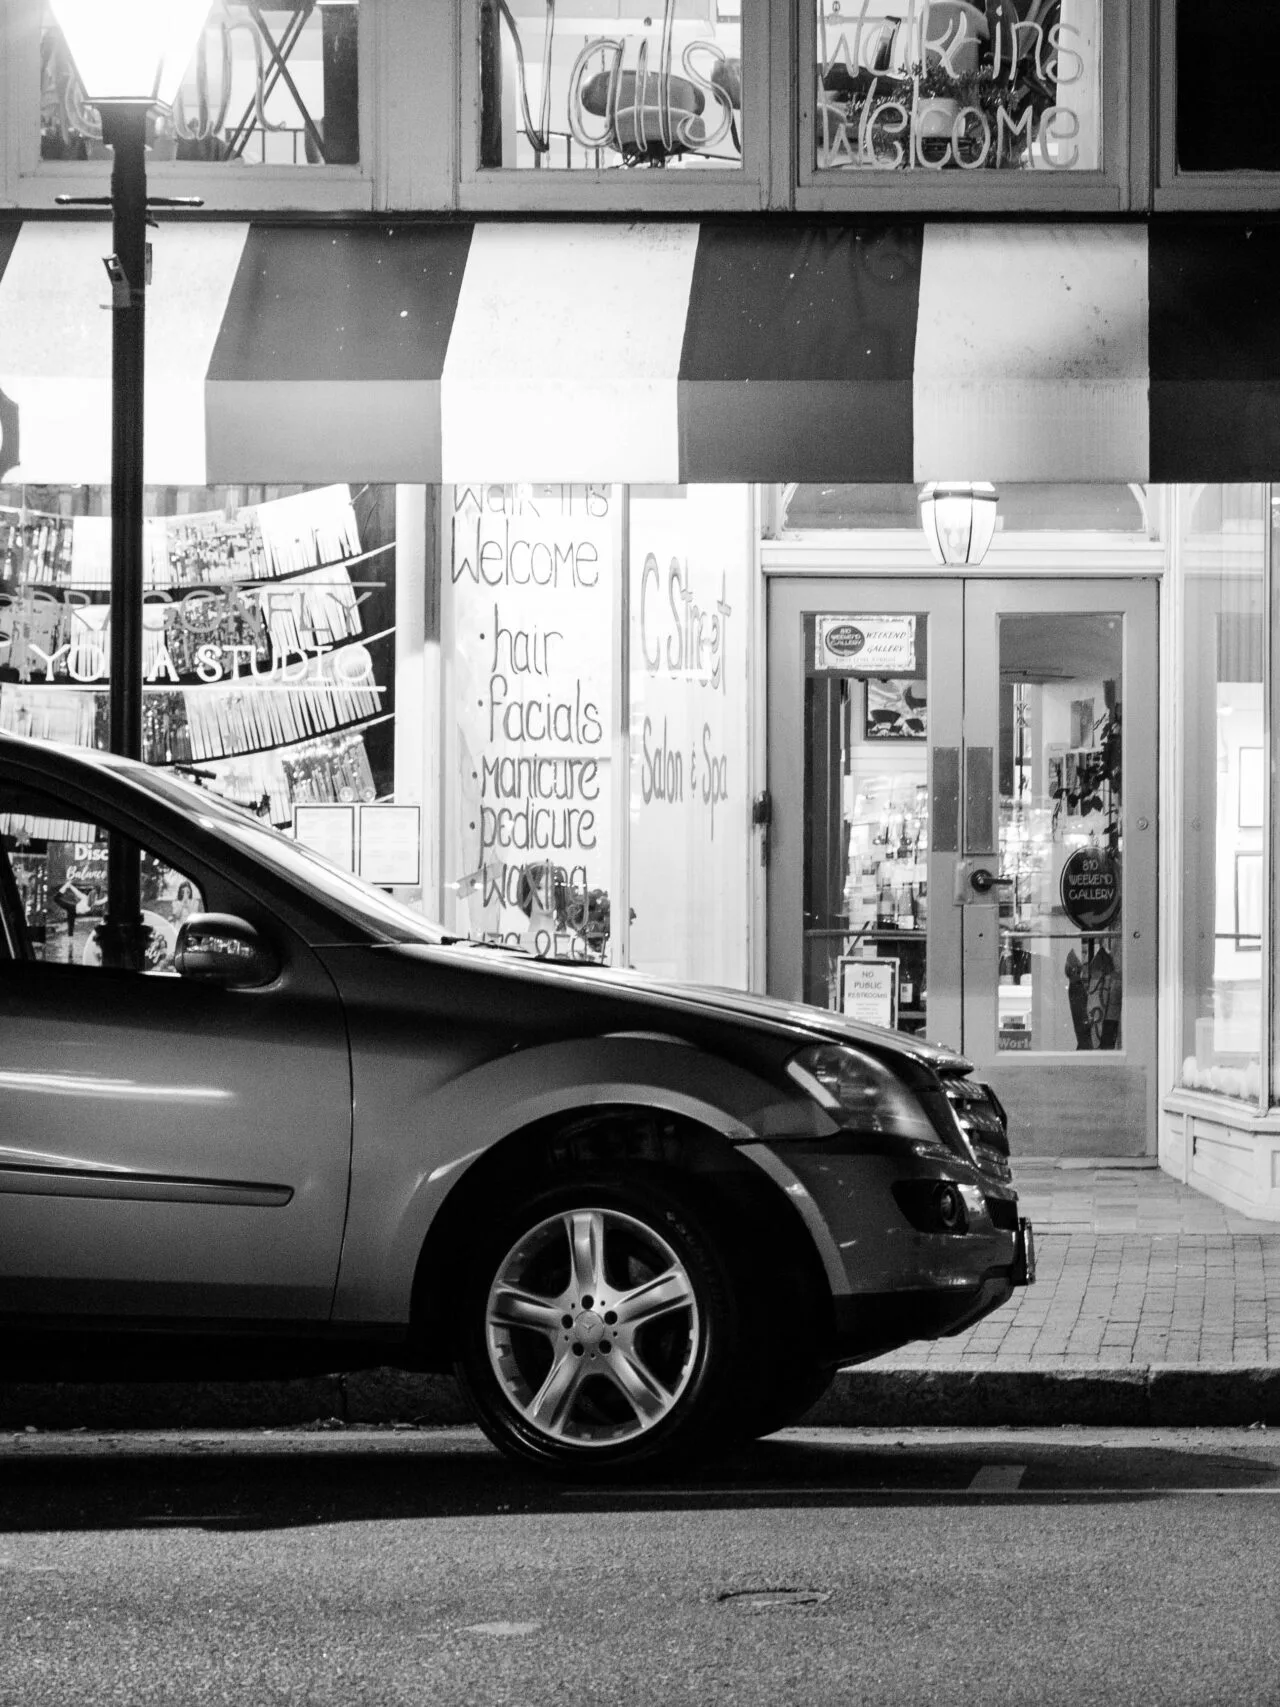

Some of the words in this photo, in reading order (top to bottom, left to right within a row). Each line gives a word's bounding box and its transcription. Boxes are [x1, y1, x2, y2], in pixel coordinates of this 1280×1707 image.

[817, 76, 1080, 170] Welcome
[451, 516, 599, 587] Welcome
[492, 603, 563, 675] hair
[667, 556, 732, 696] Street
[866, 631, 907, 639] WEEKEND
[28, 643, 181, 682] YOA
[196, 643, 374, 683] STUDIO
[490, 674, 603, 744] facials
[642, 715, 684, 804] Salon
[703, 722, 729, 842] Spa
[480, 800, 597, 869] pedicure
[1069, 873, 1114, 886] WEEKEND
[1082, 859, 1099, 871] 810
[1069, 888, 1114, 901] GALLERY
[854, 981, 882, 989] PUBLIC
[862, 970, 874, 978] NO
